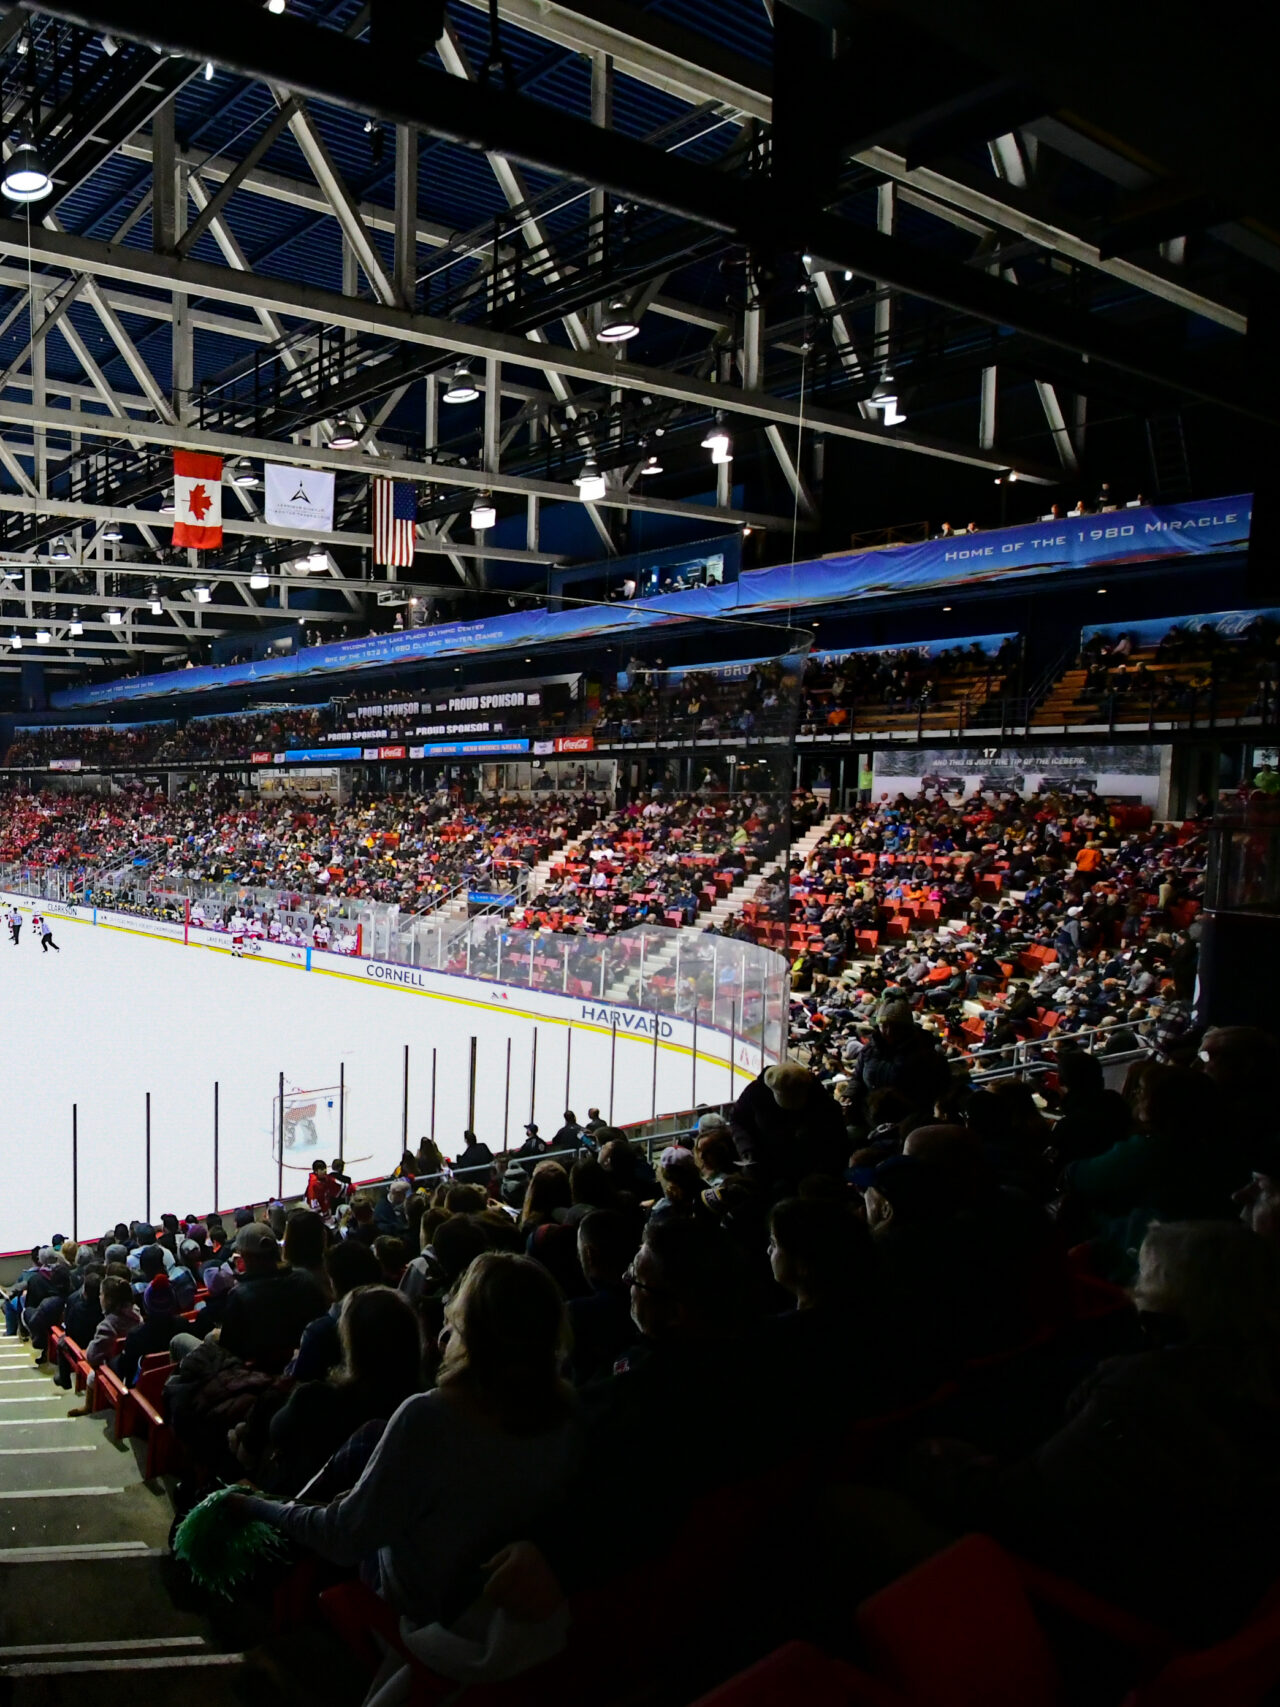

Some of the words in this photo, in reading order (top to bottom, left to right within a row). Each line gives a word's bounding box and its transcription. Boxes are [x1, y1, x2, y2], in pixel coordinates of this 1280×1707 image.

[945, 546, 994, 562] HOME
[1002, 542, 1024, 554] OF
[1031, 536, 1066, 549] THE
[1078, 526, 1134, 542] 1980
[1145, 513, 1238, 534] MIRACLE
[444, 636, 472, 645] WINTER
[475, 632, 503, 641] GAMES
[449, 696, 478, 712] PROUD
[480, 692, 524, 708] SPONSOR
[358, 706, 382, 718] PROUD
[384, 702, 419, 717] SPONSOR
[416, 726, 445, 736] PROUD
[446, 722, 490, 734] SPONSOR
[328, 732, 352, 742] PROUD
[352, 730, 388, 740] SPONSOR
[564, 738, 588, 750] Coca-Cola
[726, 755, 736, 764] 18
[983, 748, 997, 758] 17
[1051, 757, 1088, 765] ICEBERG.
[48, 903, 78, 916] CLARKSON
[366, 964, 426, 988] CORNELL
[581, 1004, 673, 1038] HARVARD
